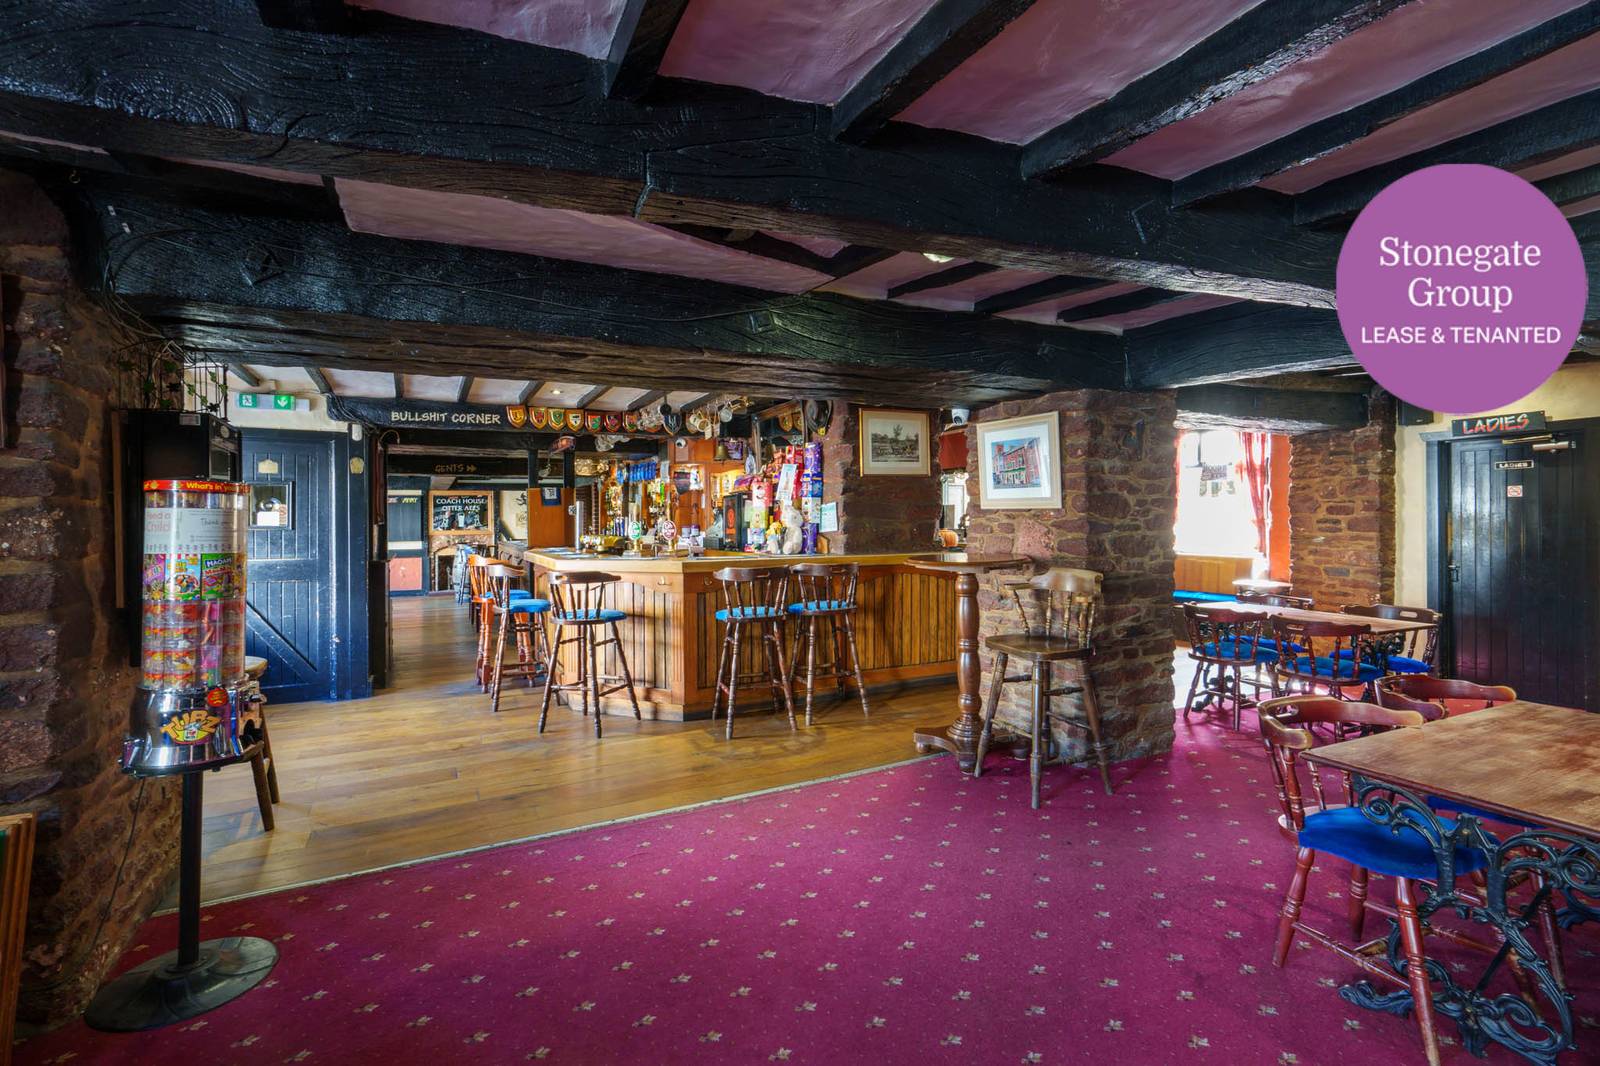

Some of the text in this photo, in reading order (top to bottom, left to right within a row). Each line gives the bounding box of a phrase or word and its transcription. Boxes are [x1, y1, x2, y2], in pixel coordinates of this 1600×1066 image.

[391, 411, 501, 425] BULLSHIT CORNER
[1462, 413, 1529, 434] LADIES
[434, 464, 464, 473] GENTS
[186, 482, 213, 490] What's
[160, 710, 222, 740] TUBZ
